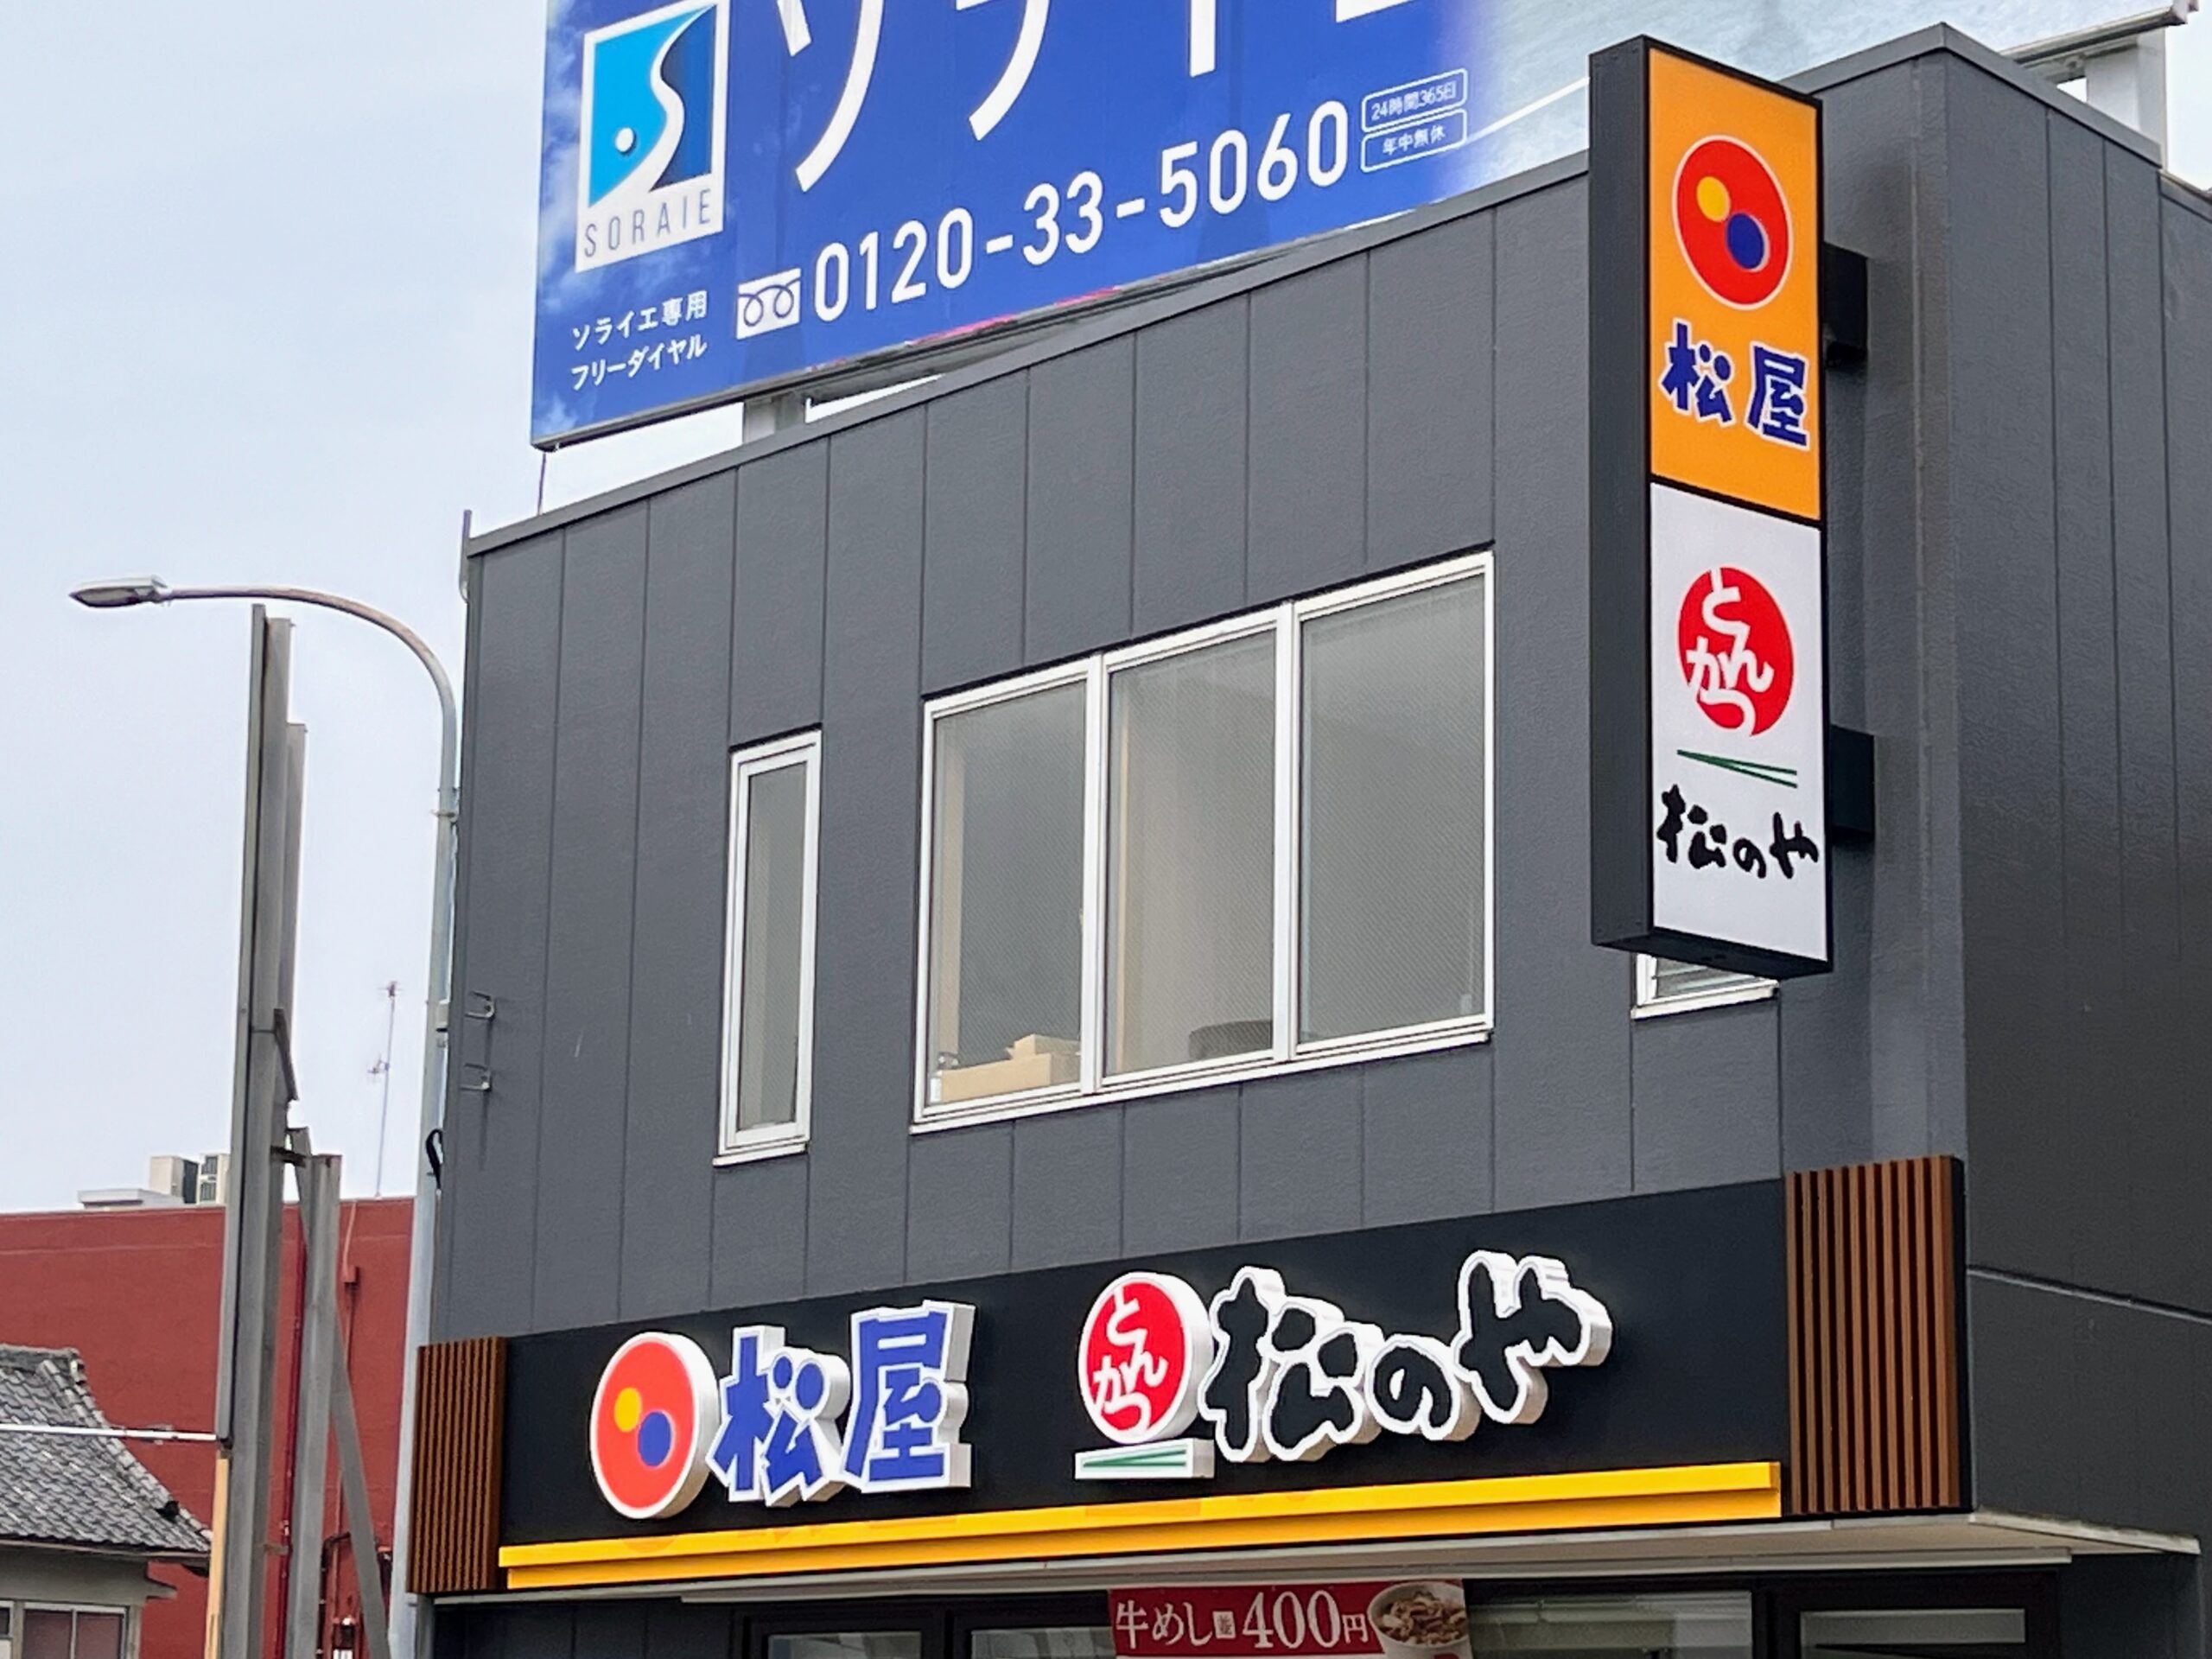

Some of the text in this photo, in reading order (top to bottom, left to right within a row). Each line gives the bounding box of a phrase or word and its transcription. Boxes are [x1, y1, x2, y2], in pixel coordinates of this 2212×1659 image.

[1370, 80, 1457, 120] 24時間365日
[1382, 124, 1445, 155] 年中無休
[584, 188, 711, 257] SORAIE
[813, 100, 1348, 321] 0120-33-5060
[572, 290, 708, 351] ソライエ専用
[571, 334, 707, 391] フリーダイヤル
[1658, 318, 1810, 450] 松屋
[1656, 784, 1819, 880] 松のや
[1199, 1252, 1599, 1460] 松のや
[706, 1300, 969, 1507] 松屋
